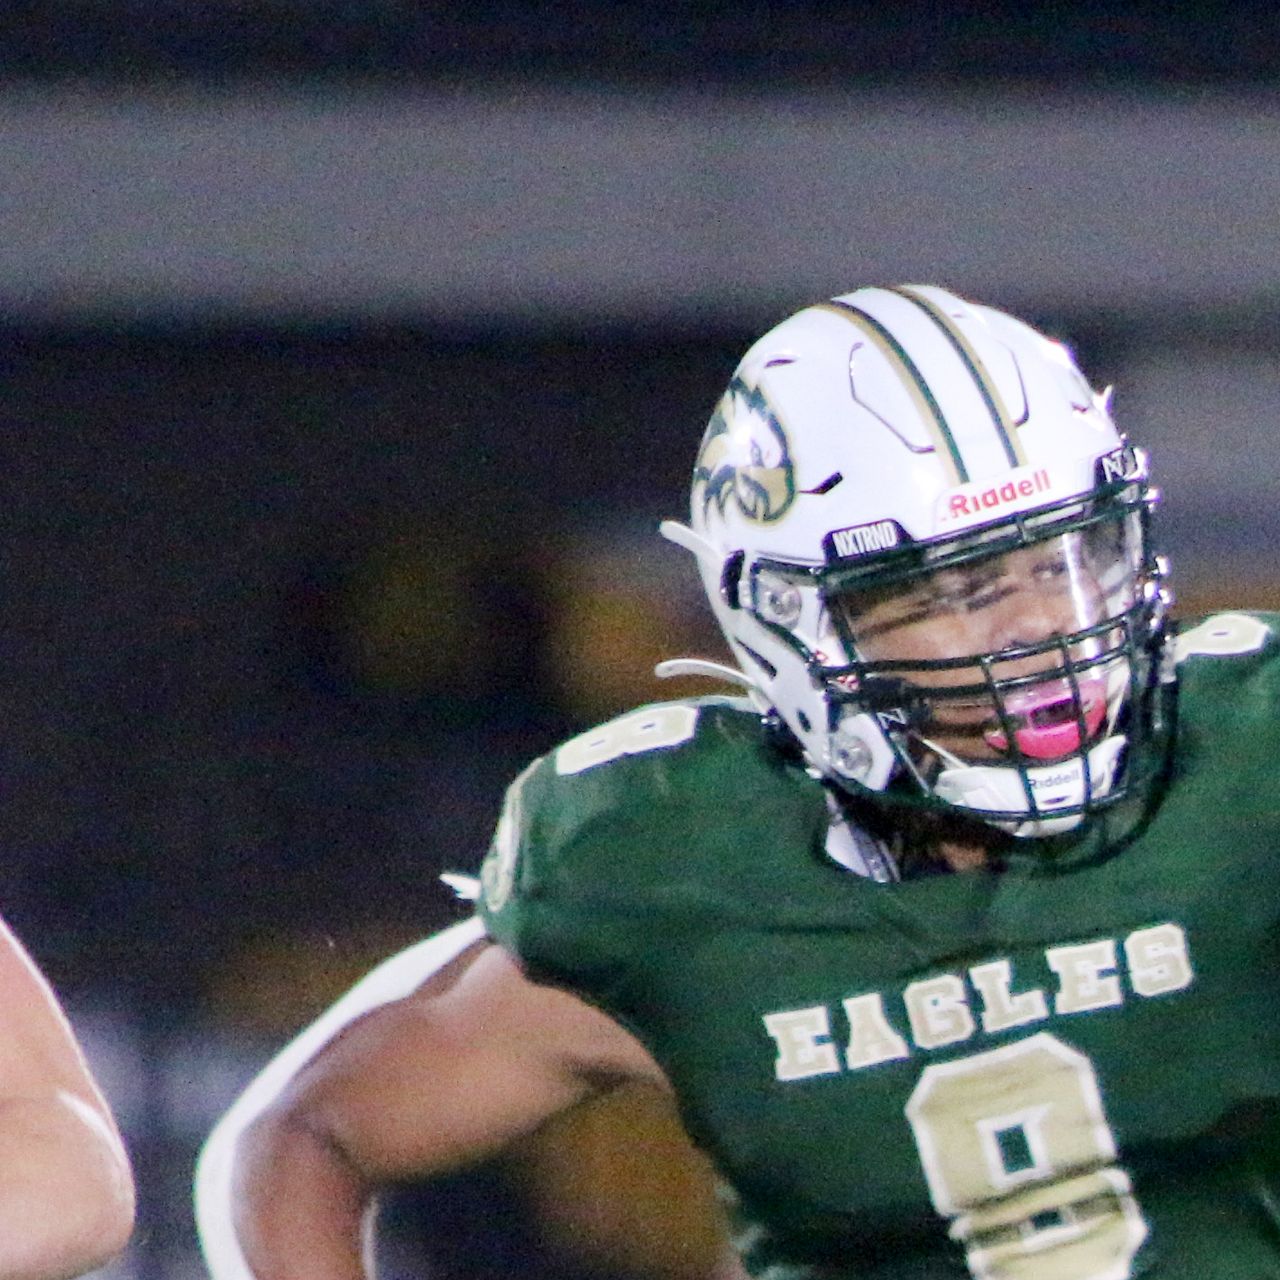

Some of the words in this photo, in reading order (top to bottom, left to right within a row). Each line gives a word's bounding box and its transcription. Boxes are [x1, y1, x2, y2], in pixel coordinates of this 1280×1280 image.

[948, 469, 1051, 520] Riddell
[831, 520, 898, 558] NXTRND
[555, 705, 699, 776] 8
[763, 922, 1194, 1081] EAGLES
